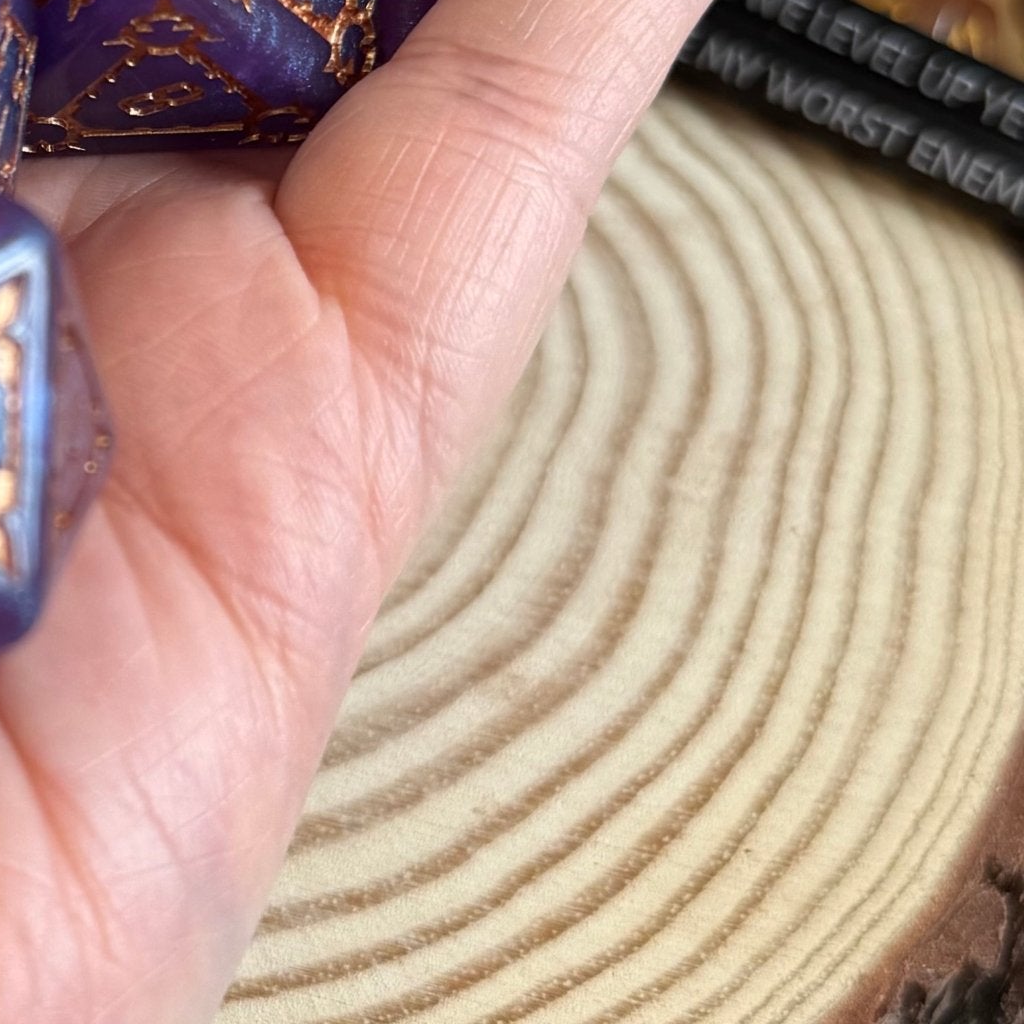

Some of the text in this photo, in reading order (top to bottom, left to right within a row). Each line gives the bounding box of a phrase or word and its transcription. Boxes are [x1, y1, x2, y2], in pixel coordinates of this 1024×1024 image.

[695, 36, 764, 90] MY
[766, 61, 917, 157] WORST
[907, 132, 1024, 216] ENEM
[807, 2, 914, 88] LEVEL
[918, 56, 976, 109] UP
